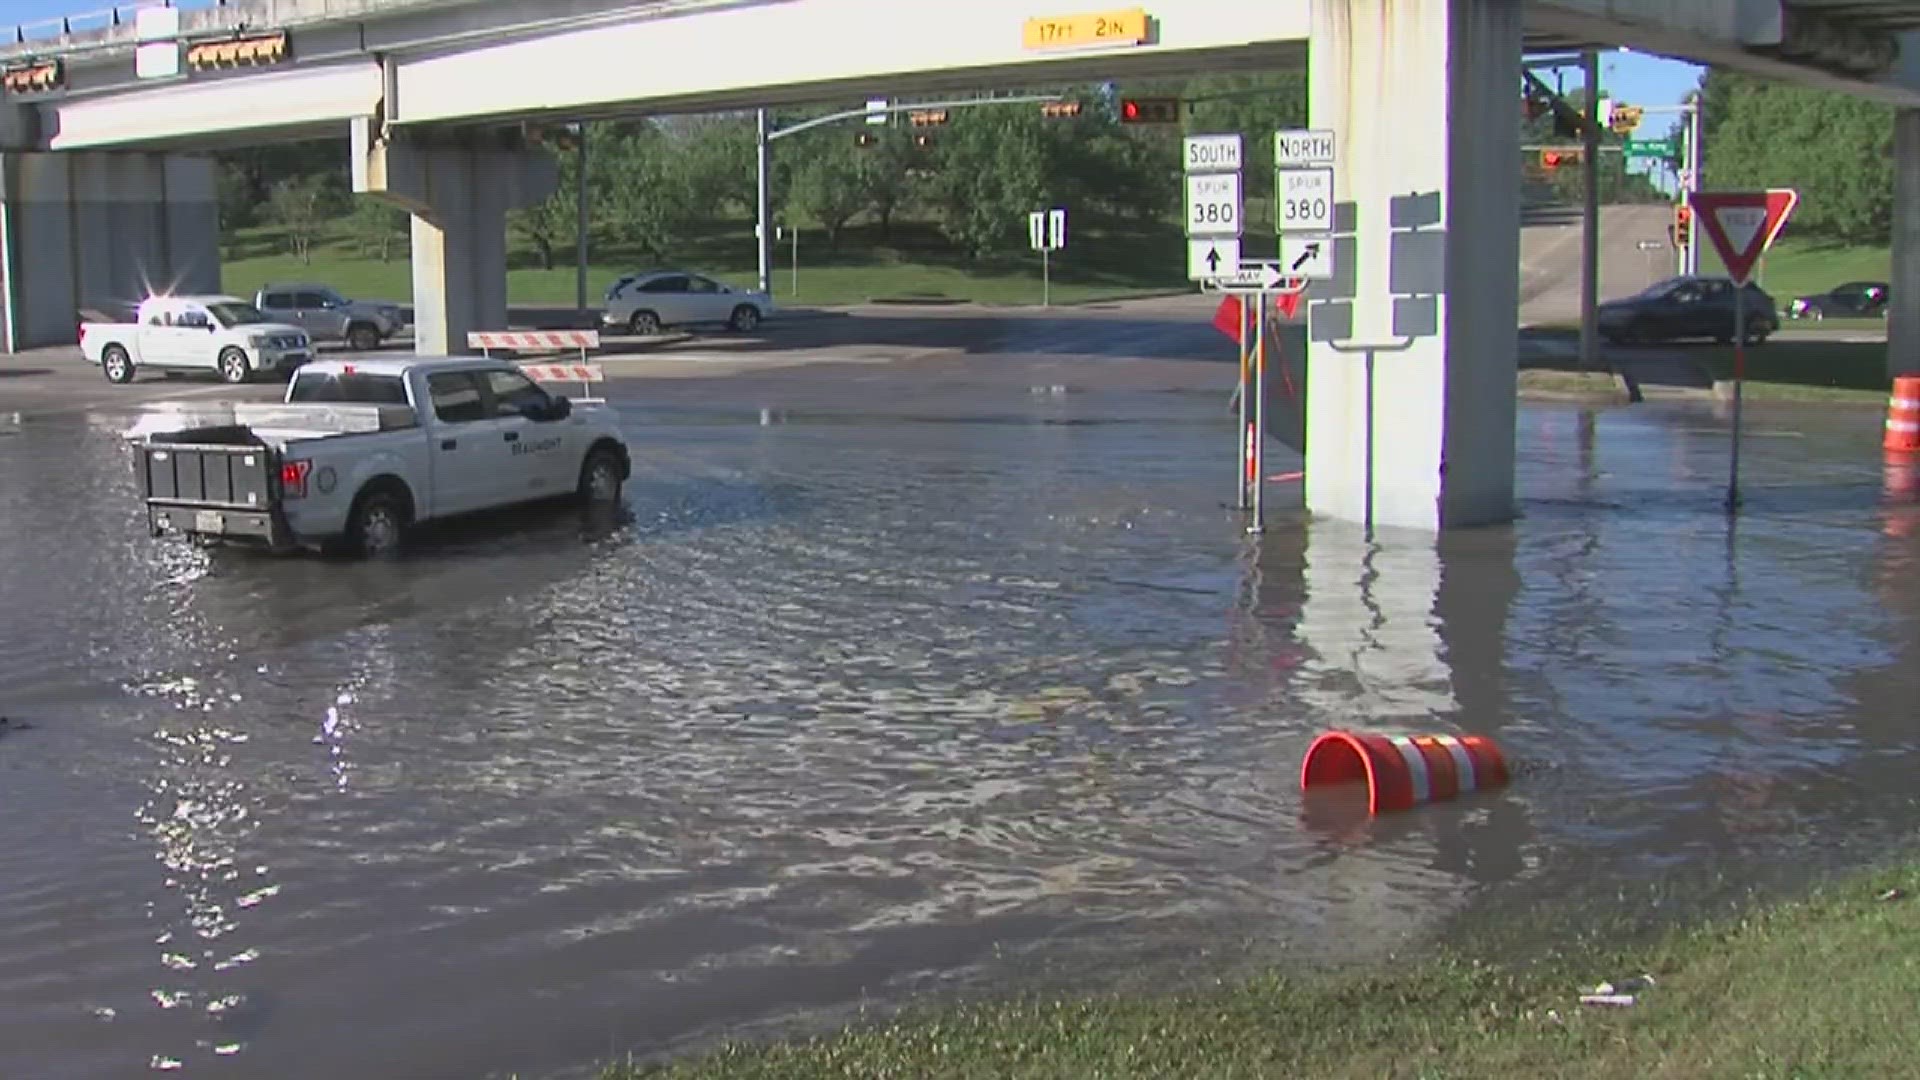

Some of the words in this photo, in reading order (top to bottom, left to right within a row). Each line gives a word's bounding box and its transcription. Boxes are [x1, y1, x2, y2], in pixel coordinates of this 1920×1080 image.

[1190, 143, 1236, 163] SOUTH
[1280, 138, 1331, 157] NORTH
[1197, 181, 1229, 195] SPUR
[1288, 177, 1322, 190] SPUR
[1194, 203, 1233, 223] 380
[1285, 198, 1326, 220] 380
